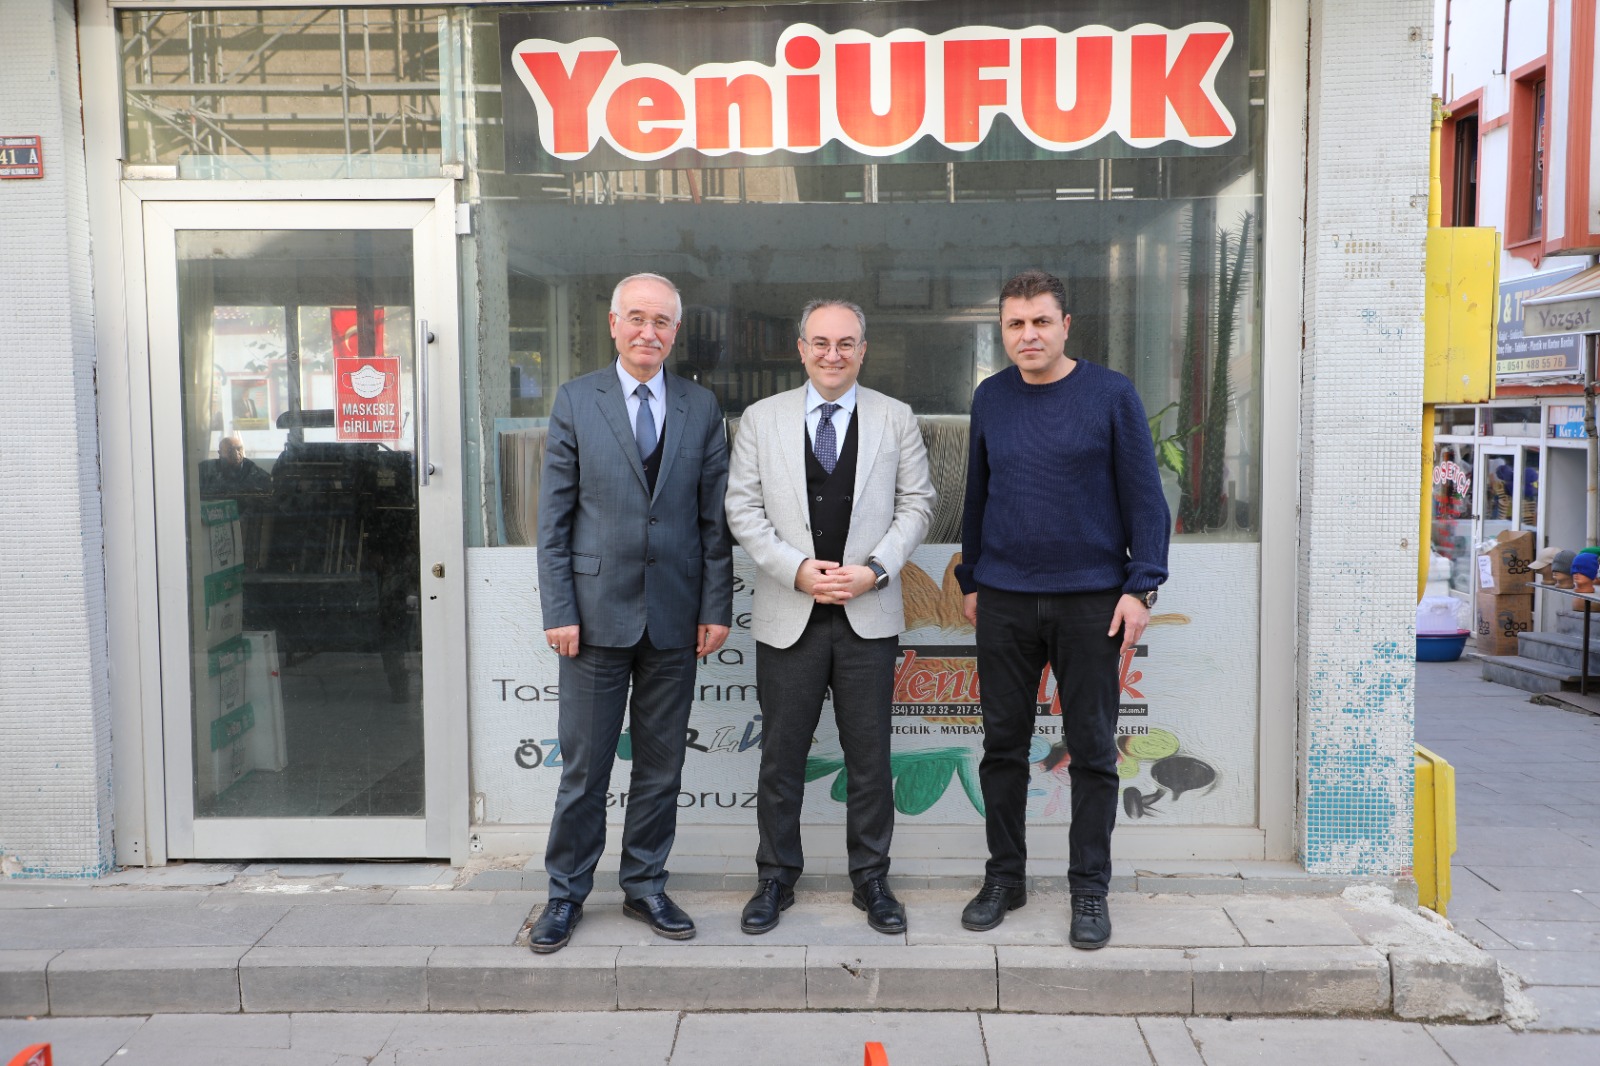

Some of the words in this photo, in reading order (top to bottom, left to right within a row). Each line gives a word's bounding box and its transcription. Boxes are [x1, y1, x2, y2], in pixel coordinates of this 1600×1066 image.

[29, 148, 39, 163] A
[1539, 308, 1591, 331] Yozgat
[1526, 359, 1540, 369] 488
[1542, 358, 1551, 368] 55
[1553, 357, 1563, 367] 76
[342, 402, 395, 416] MASKESİZ
[343, 418, 396, 433] GİRİLMEZ
[492, 679, 560, 701] Tas
[891, 706, 908, 715] 354)
[910, 706, 925, 714] 212
[926, 706, 936, 714] 32
[938, 706, 948, 714] 32
[956, 706, 970, 714] 217
[1118, 706, 1146, 714] esi.com.tr
[891, 724, 930, 735] TECİLİK
[940, 725, 985, 735] MATBAA
[1032, 725, 1057, 735] FSET
